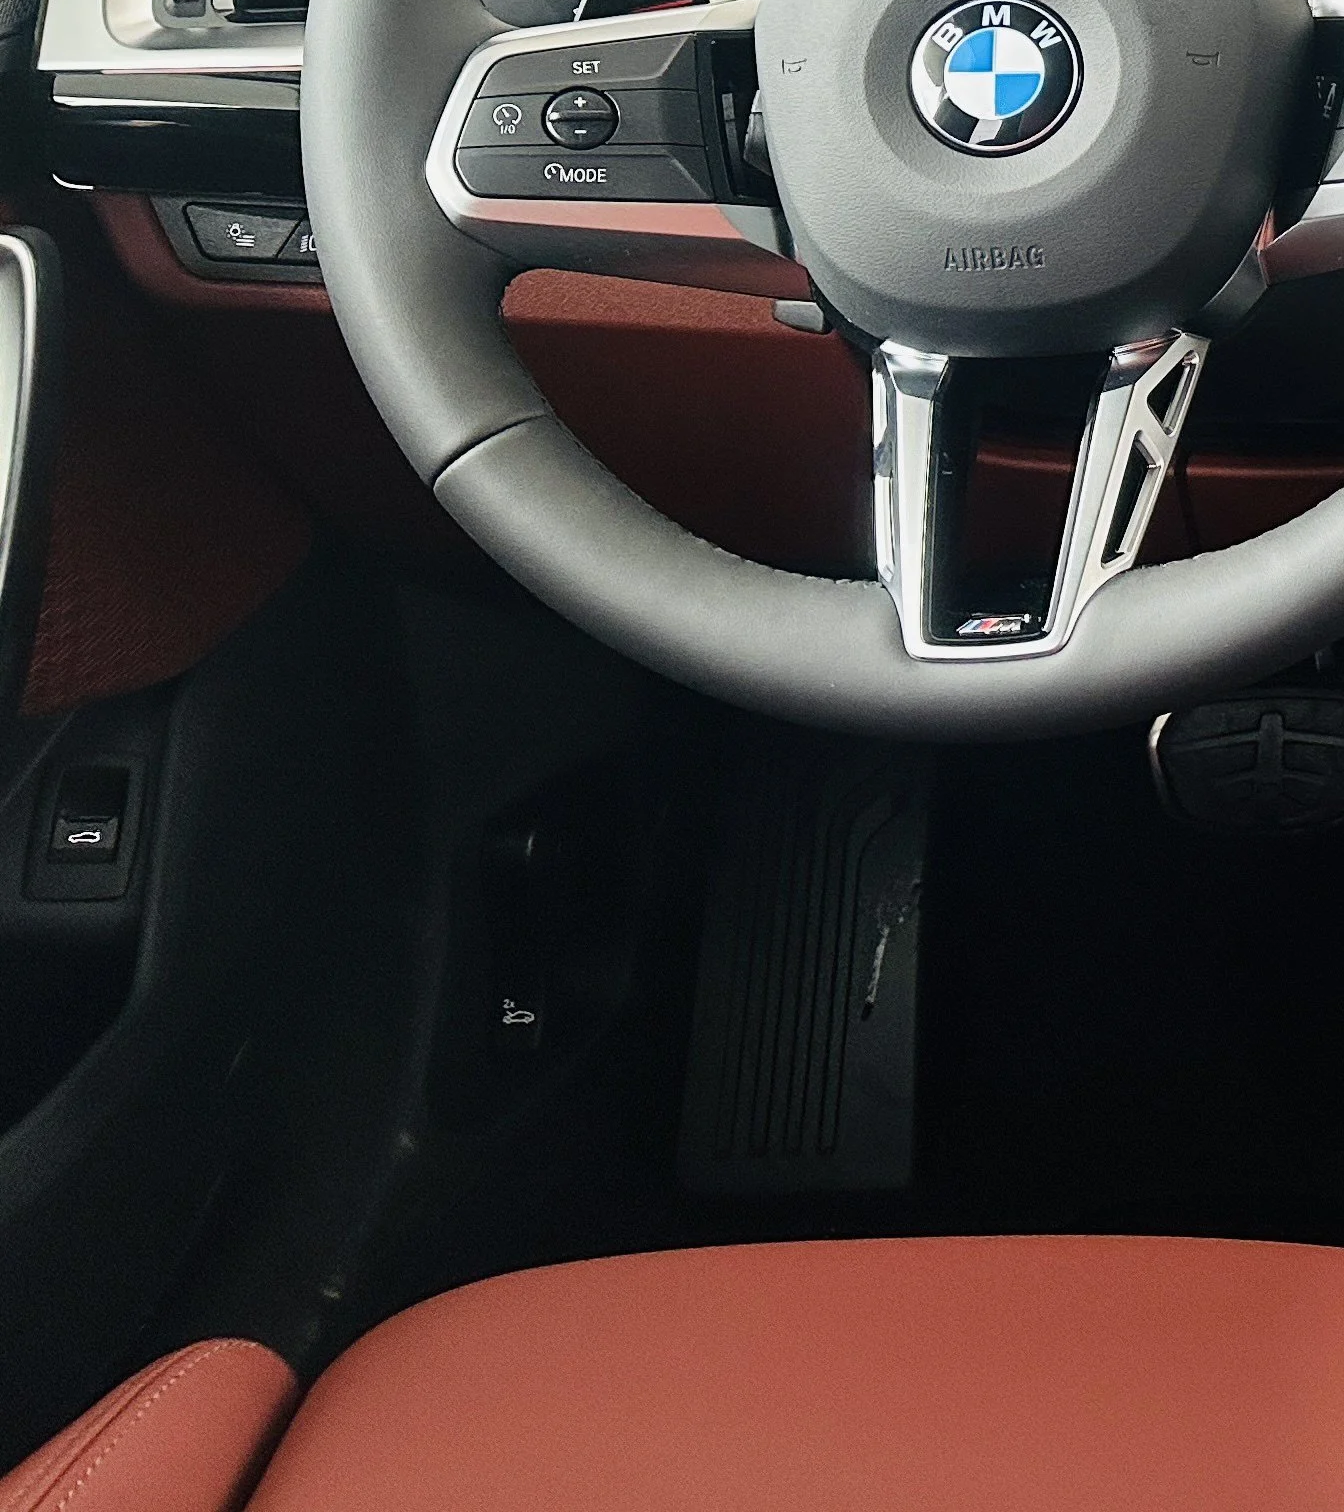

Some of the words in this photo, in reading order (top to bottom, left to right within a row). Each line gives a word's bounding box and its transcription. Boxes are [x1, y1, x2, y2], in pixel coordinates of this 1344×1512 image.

[932, 4, 1062, 52] BMW
[572, 61, 600, 74] SET
[559, 168, 607, 183] MODE
[944, 245, 1045, 271] AIRBAG
